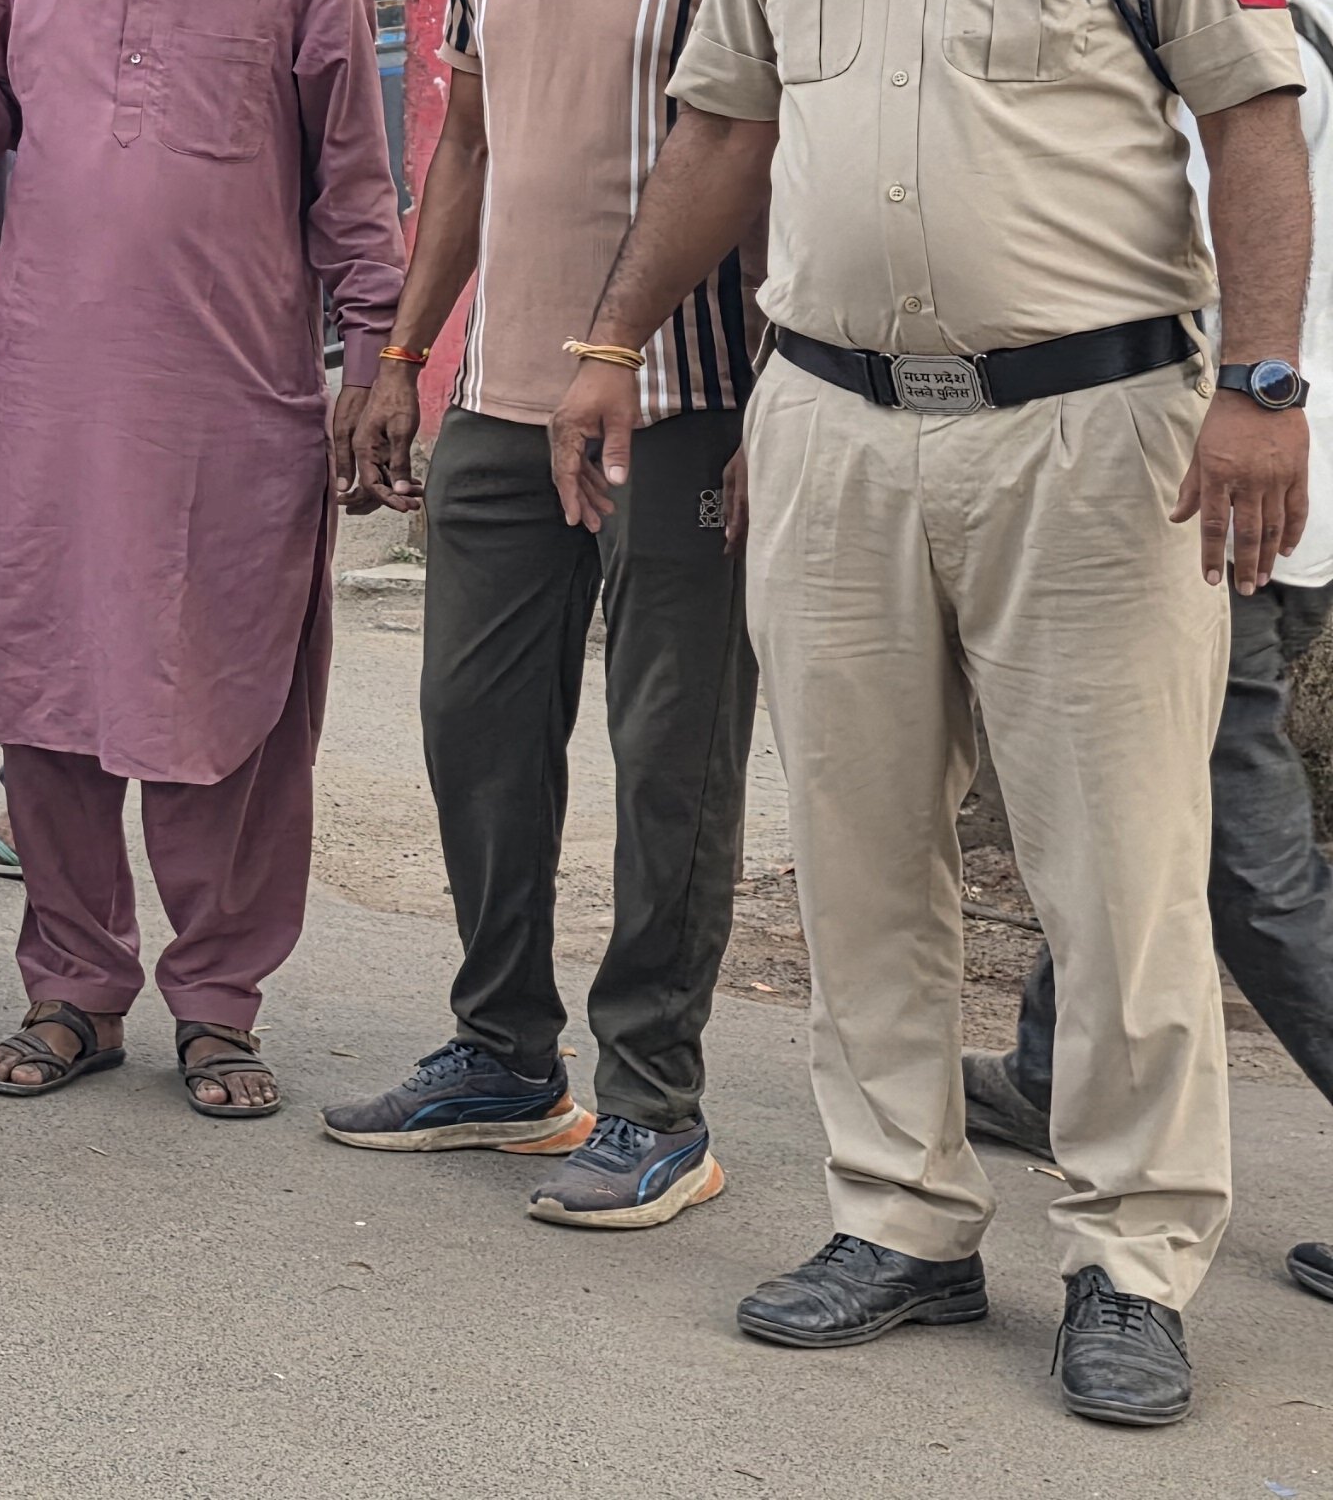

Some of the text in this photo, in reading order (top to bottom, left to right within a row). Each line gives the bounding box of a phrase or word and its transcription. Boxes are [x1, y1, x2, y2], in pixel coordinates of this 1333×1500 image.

[902, 370, 967, 385] मध्य प्रदेश
[905, 384, 971, 400] रेलवे पुलिस
